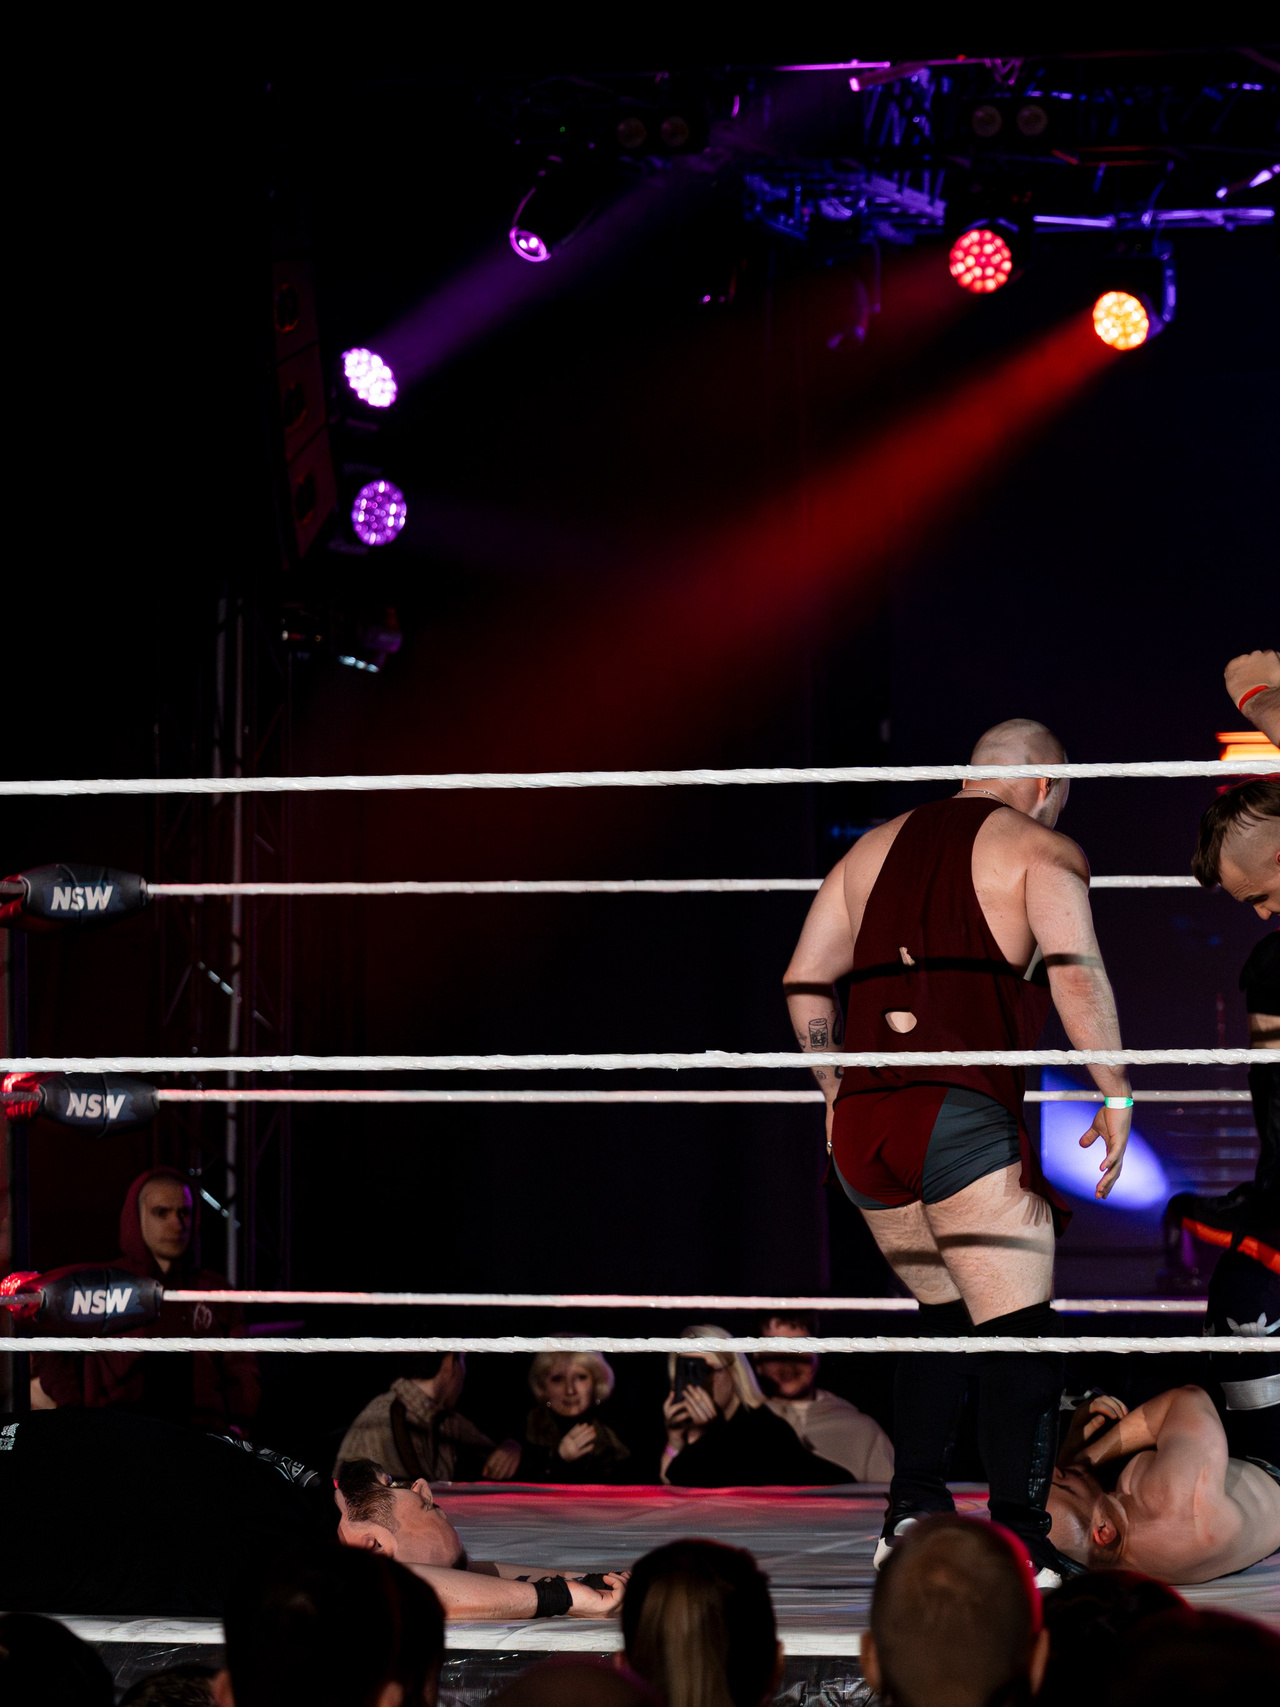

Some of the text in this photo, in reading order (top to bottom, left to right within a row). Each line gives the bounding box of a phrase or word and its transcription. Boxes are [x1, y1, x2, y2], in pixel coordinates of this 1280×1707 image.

[51, 885, 113, 911] NSW
[66, 1092, 126, 1120] NSW
[71, 1287, 132, 1316] NSW
